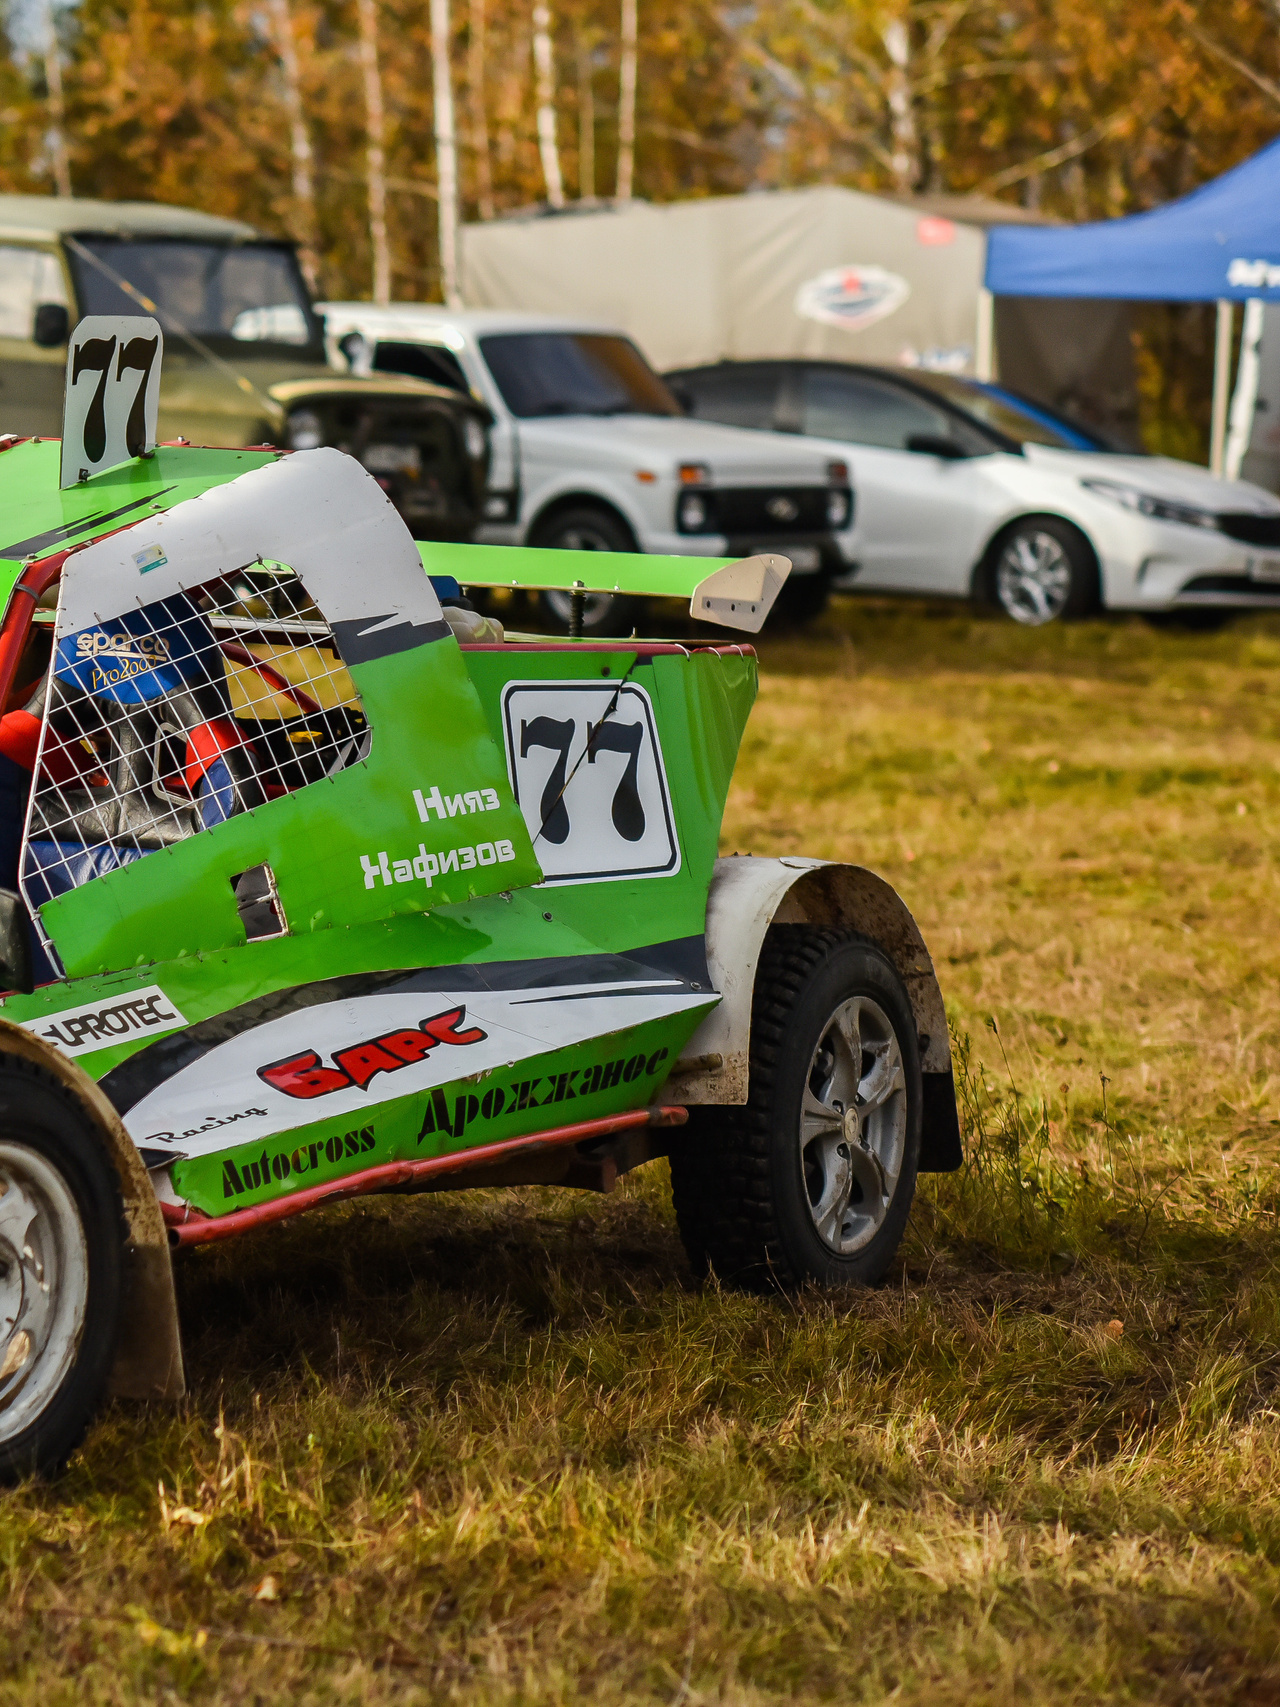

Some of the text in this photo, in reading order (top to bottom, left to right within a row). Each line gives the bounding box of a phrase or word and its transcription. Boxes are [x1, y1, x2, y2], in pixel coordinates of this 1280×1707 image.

[71, 334, 159, 464] 77
[76, 632, 171, 656] sparco
[412, 786, 501, 823] Нияз
[520, 715, 646, 845] 77
[256, 1003, 488, 1100] БАРС
[416, 1042, 670, 1145] Дрожжаное
[145, 1106, 268, 1144] Racing
[221, 1122, 376, 1199] Autocross
